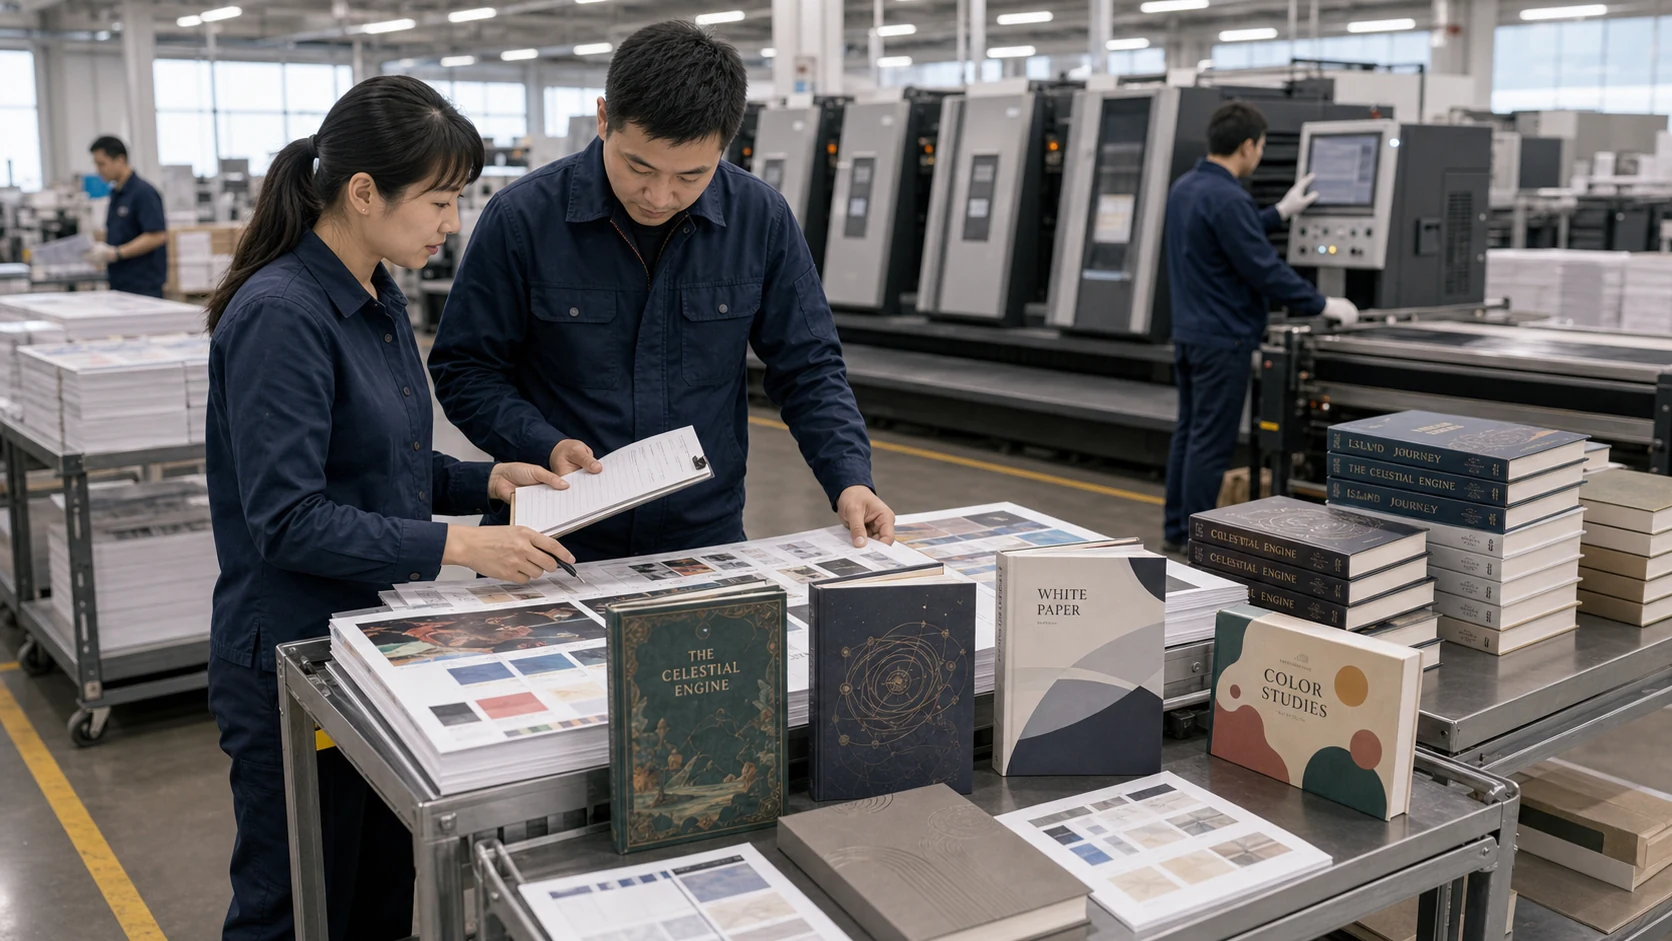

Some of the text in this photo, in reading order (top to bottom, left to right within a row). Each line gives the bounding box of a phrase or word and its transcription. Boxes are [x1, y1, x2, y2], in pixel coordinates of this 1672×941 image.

[1393, 447, 1442, 464] JOURNEY
[1348, 463, 1367, 475] THE
[1419, 476, 1456, 491] ENGINE
[1389, 497, 1439, 515] JOURNEY
[1263, 542, 1298, 559] ENGINE
[1262, 566, 1297, 584] ENGINE
[1037, 587, 1088, 601] WHITE
[1261, 591, 1295, 609] ENGINE
[1037, 603, 1081, 616] PAPER
[687, 648, 715, 662] THE
[661, 661, 741, 682] CELESTIAL
[675, 679, 730, 697] ENGINE
[1263, 668, 1323, 699] COLOR
[1261, 685, 1328, 719] STUDIES
